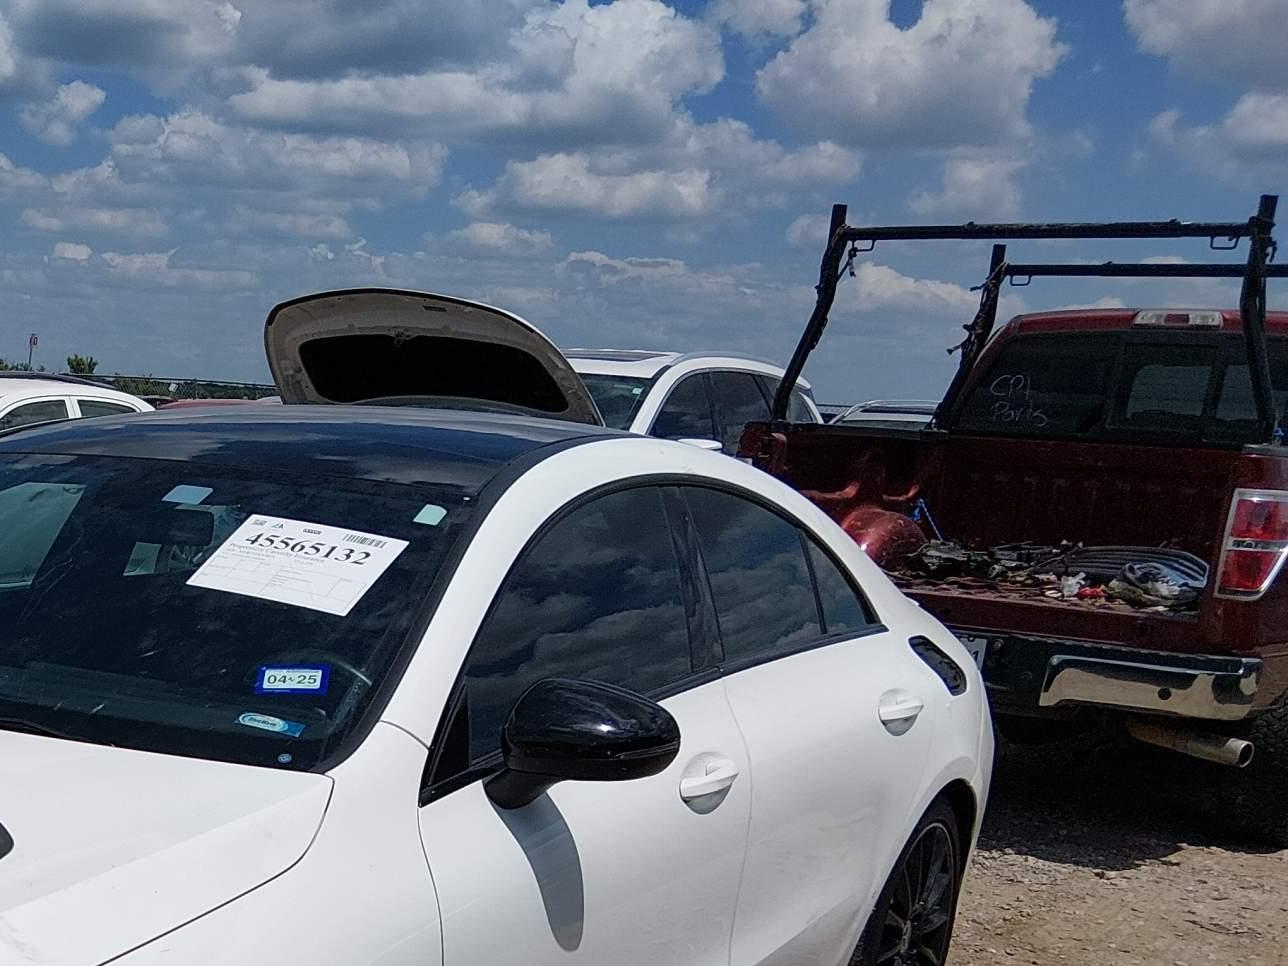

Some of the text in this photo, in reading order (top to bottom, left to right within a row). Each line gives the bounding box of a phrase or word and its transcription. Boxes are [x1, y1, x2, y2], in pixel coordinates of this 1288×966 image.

[245, 532, 372, 566] 45565132
[267, 674, 318, 685] 04 25
